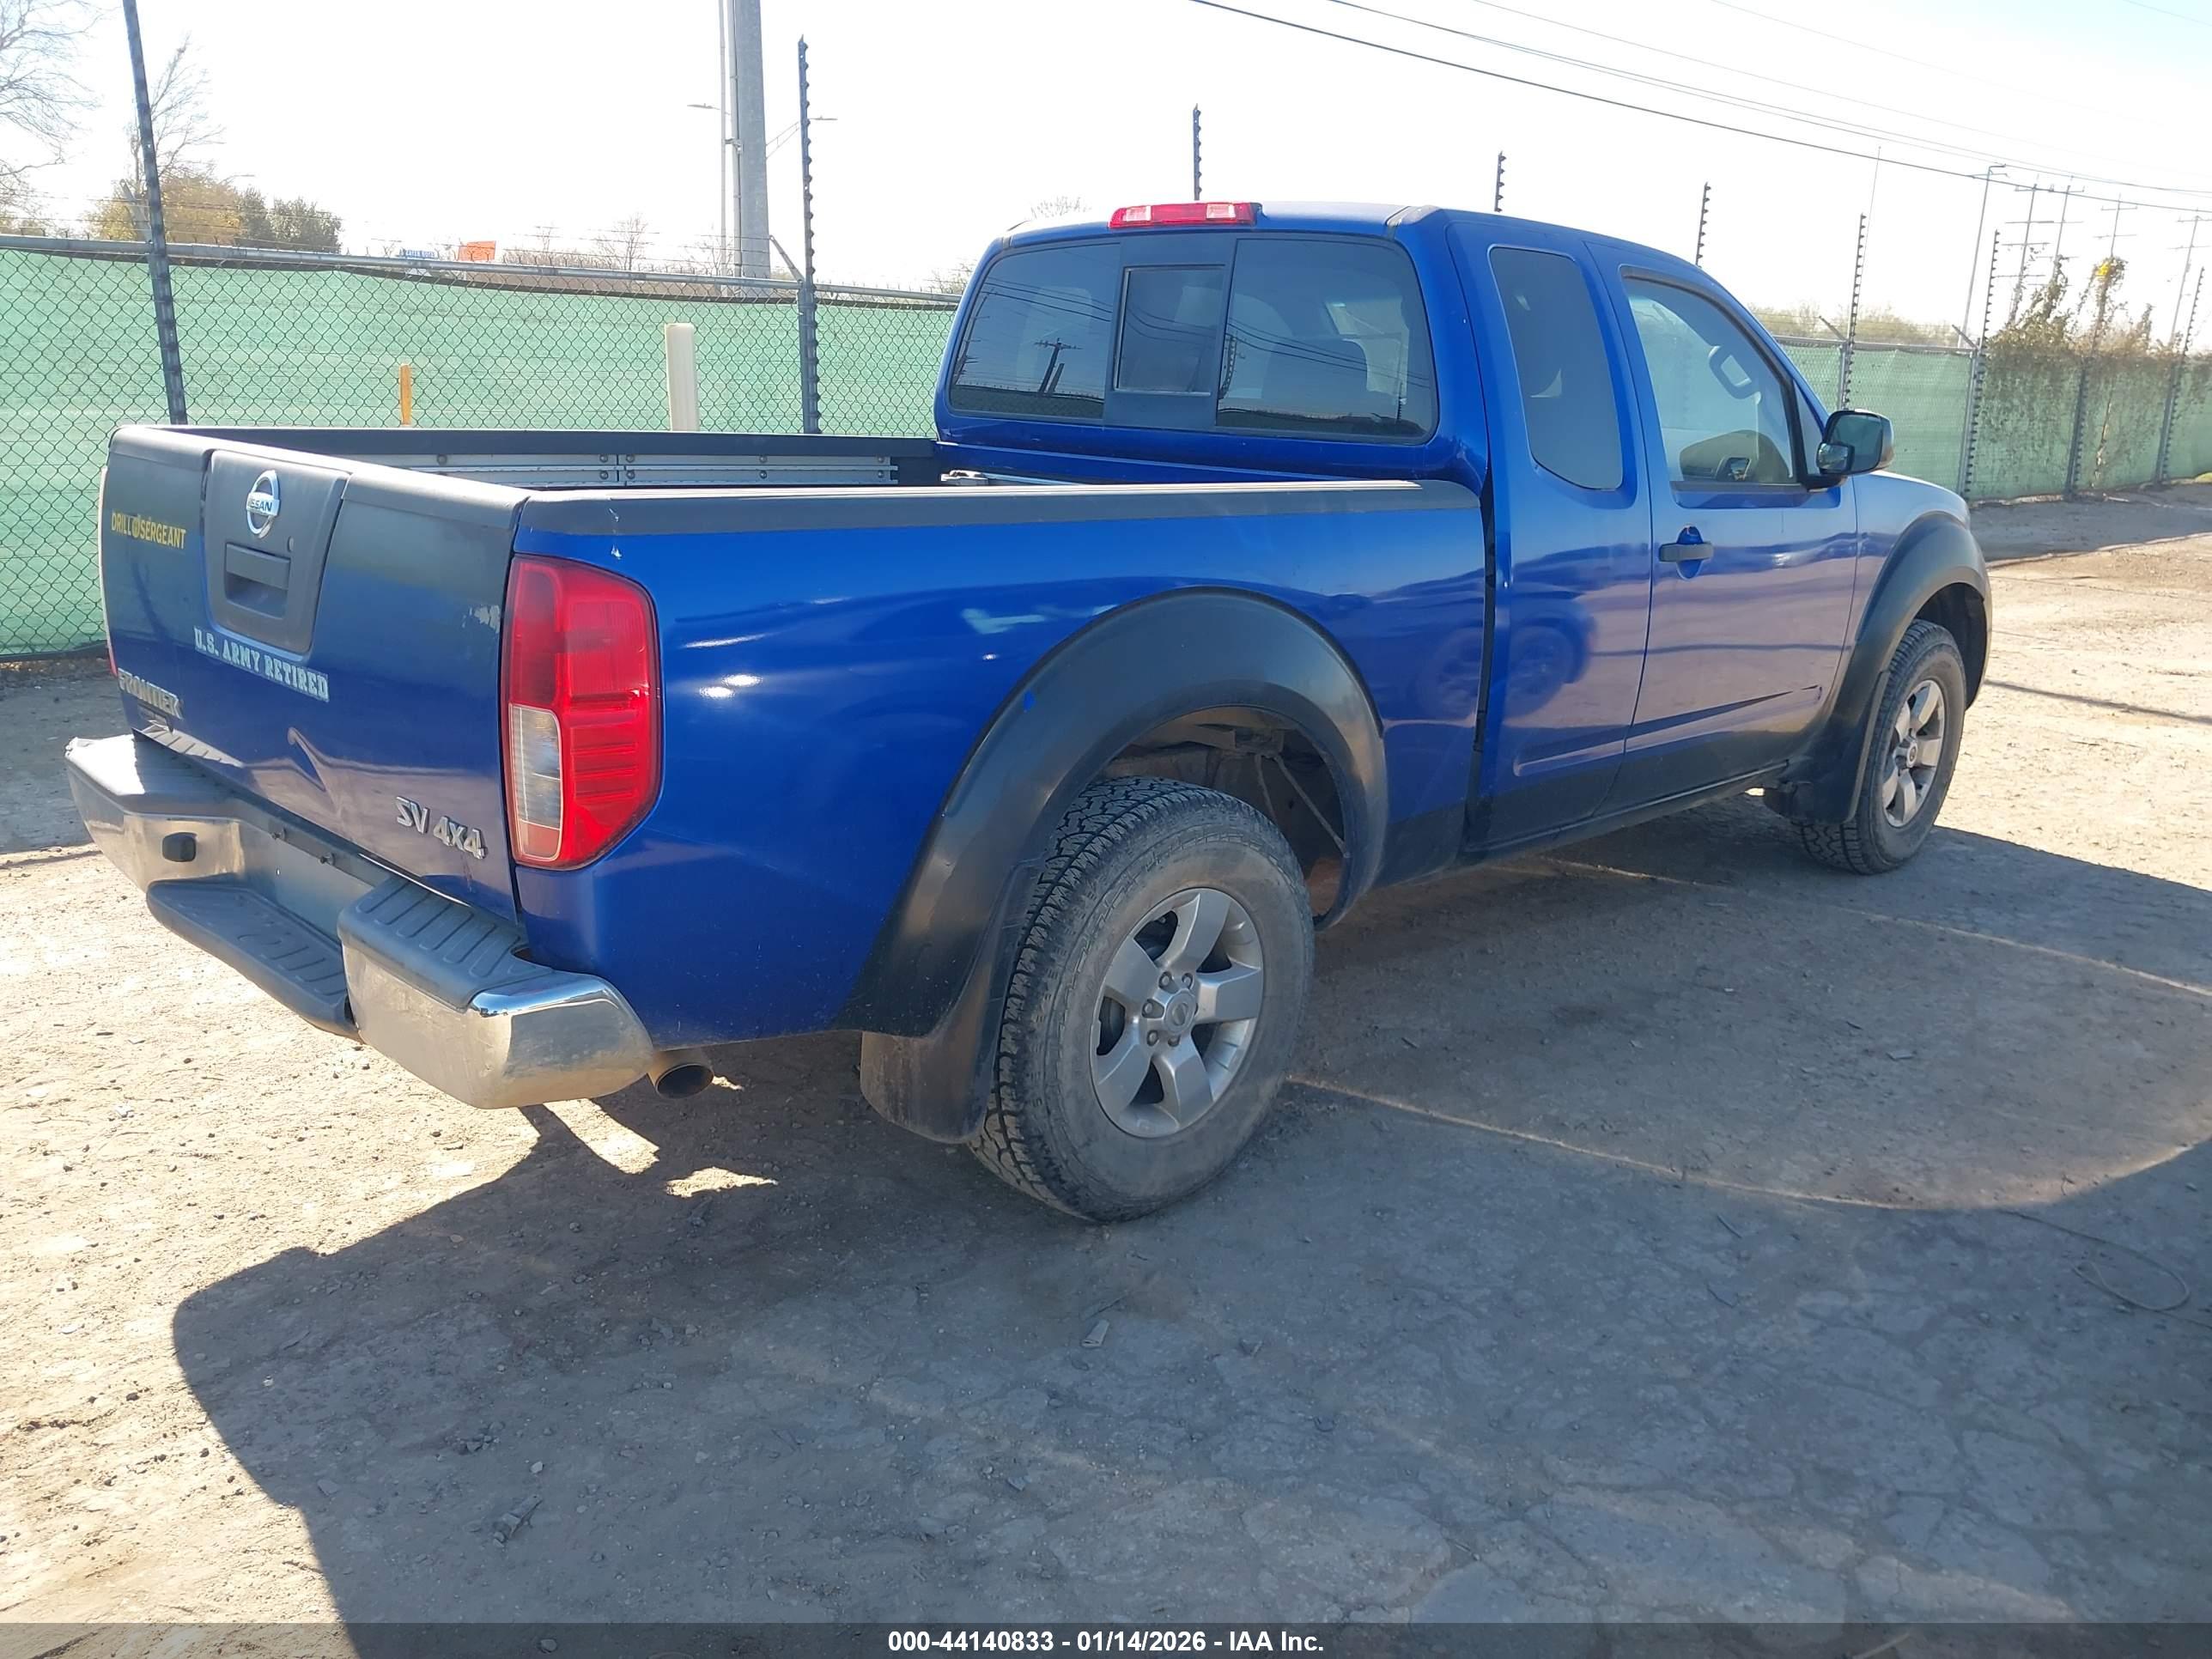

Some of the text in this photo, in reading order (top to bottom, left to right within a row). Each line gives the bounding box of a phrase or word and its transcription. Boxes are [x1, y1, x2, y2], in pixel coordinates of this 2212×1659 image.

[111, 512, 186, 550] DRILL SERGEANT
[193, 627, 330, 702] U.S. ARMY RETIRED
[118, 667, 183, 720] FRONTIER
[396, 795, 429, 835] SV
